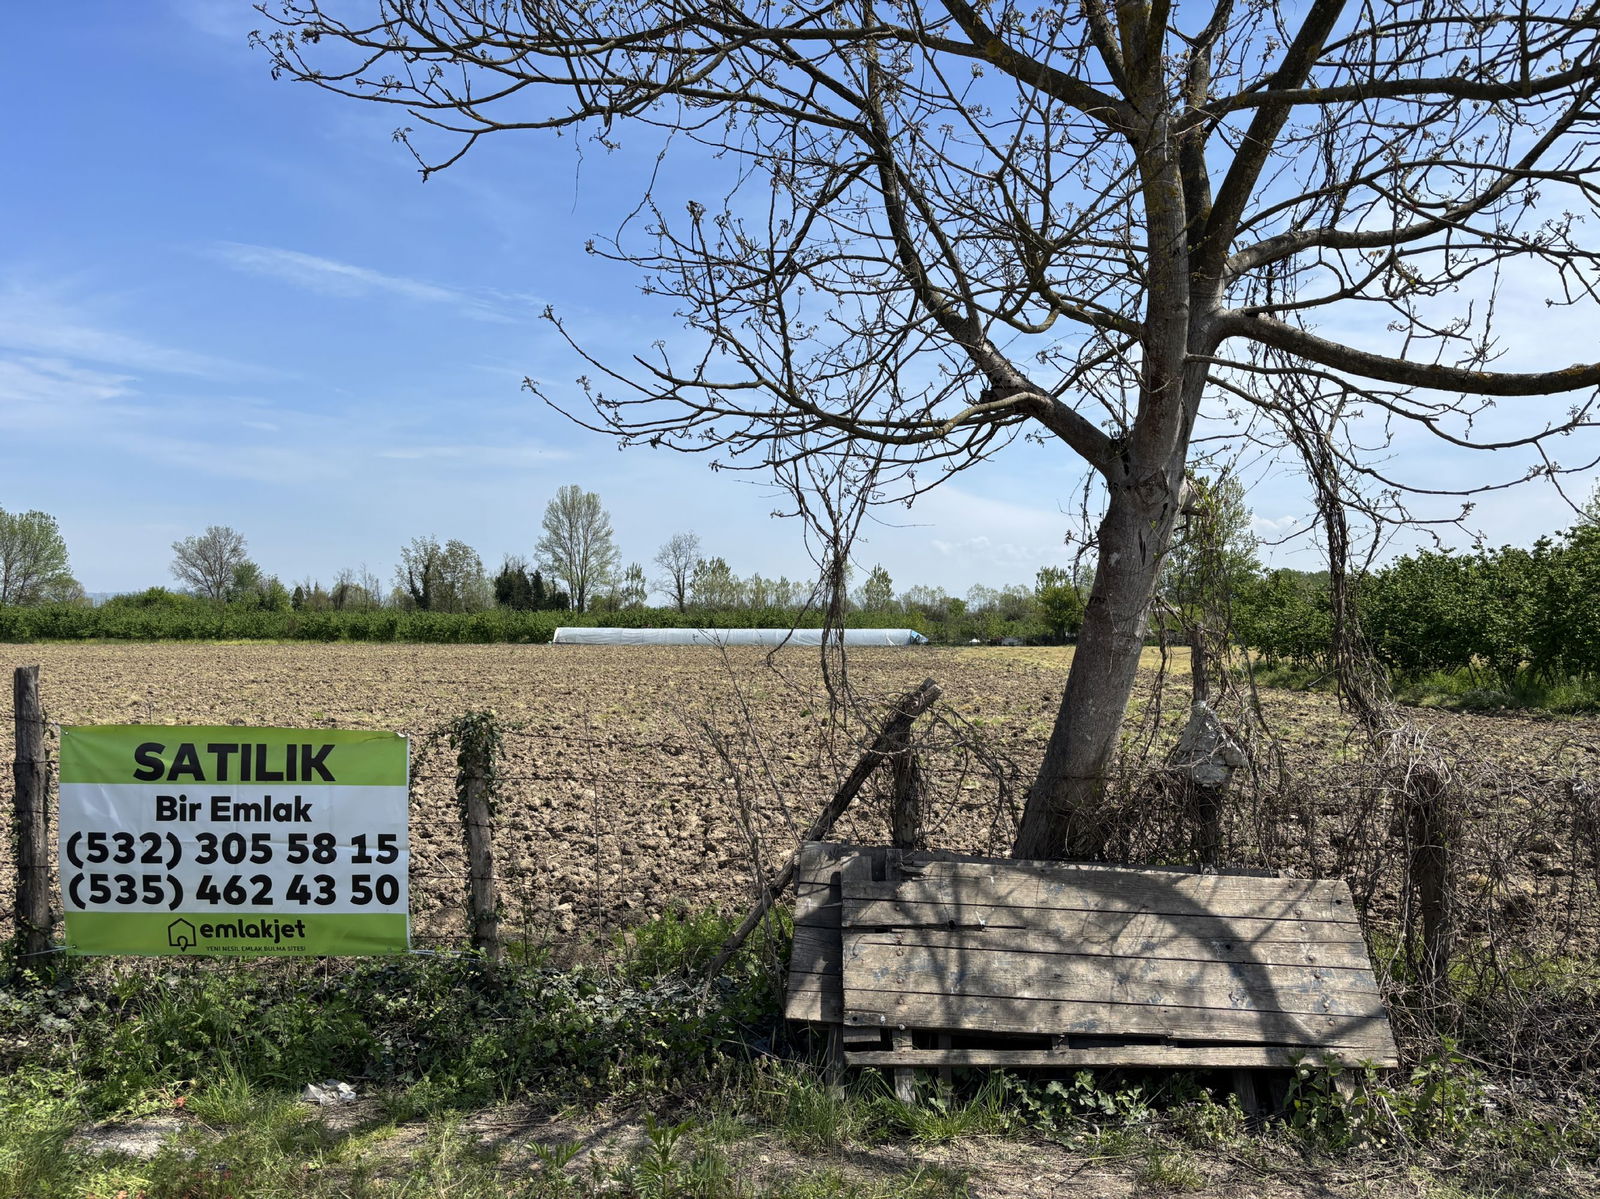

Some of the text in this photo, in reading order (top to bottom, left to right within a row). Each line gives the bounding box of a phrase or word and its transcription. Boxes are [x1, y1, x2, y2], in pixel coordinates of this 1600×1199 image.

[133, 743, 336, 782] SATILIK
[156, 795, 313, 823] Bir Emlak
[67, 831, 399, 871] (532) 305 58 15
[69, 872, 400, 911] (535) 462 43 50
[199, 918, 306, 943] emlakjet
